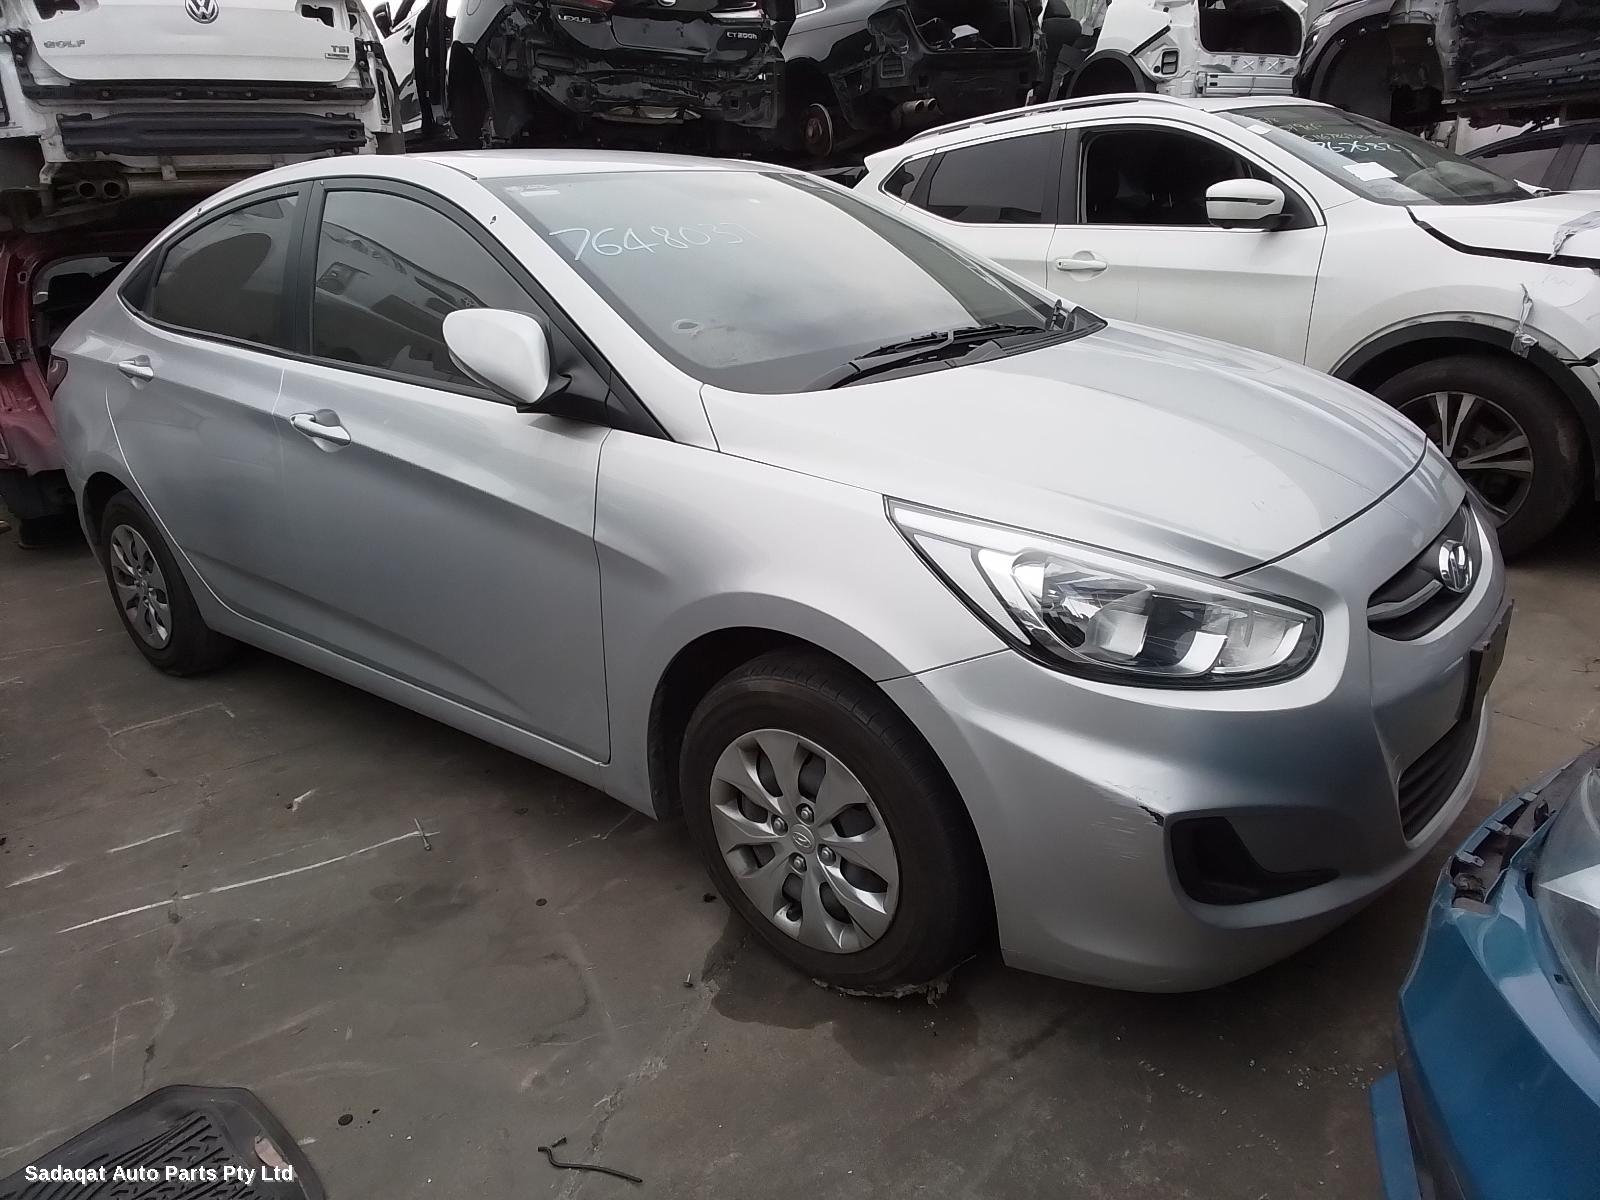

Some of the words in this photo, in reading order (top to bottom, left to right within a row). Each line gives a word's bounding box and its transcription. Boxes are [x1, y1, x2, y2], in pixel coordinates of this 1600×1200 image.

[557, 14, 591, 24] LEXUS
[43, 39, 86, 49] GOLF
[330, 45, 350, 53] TSI
